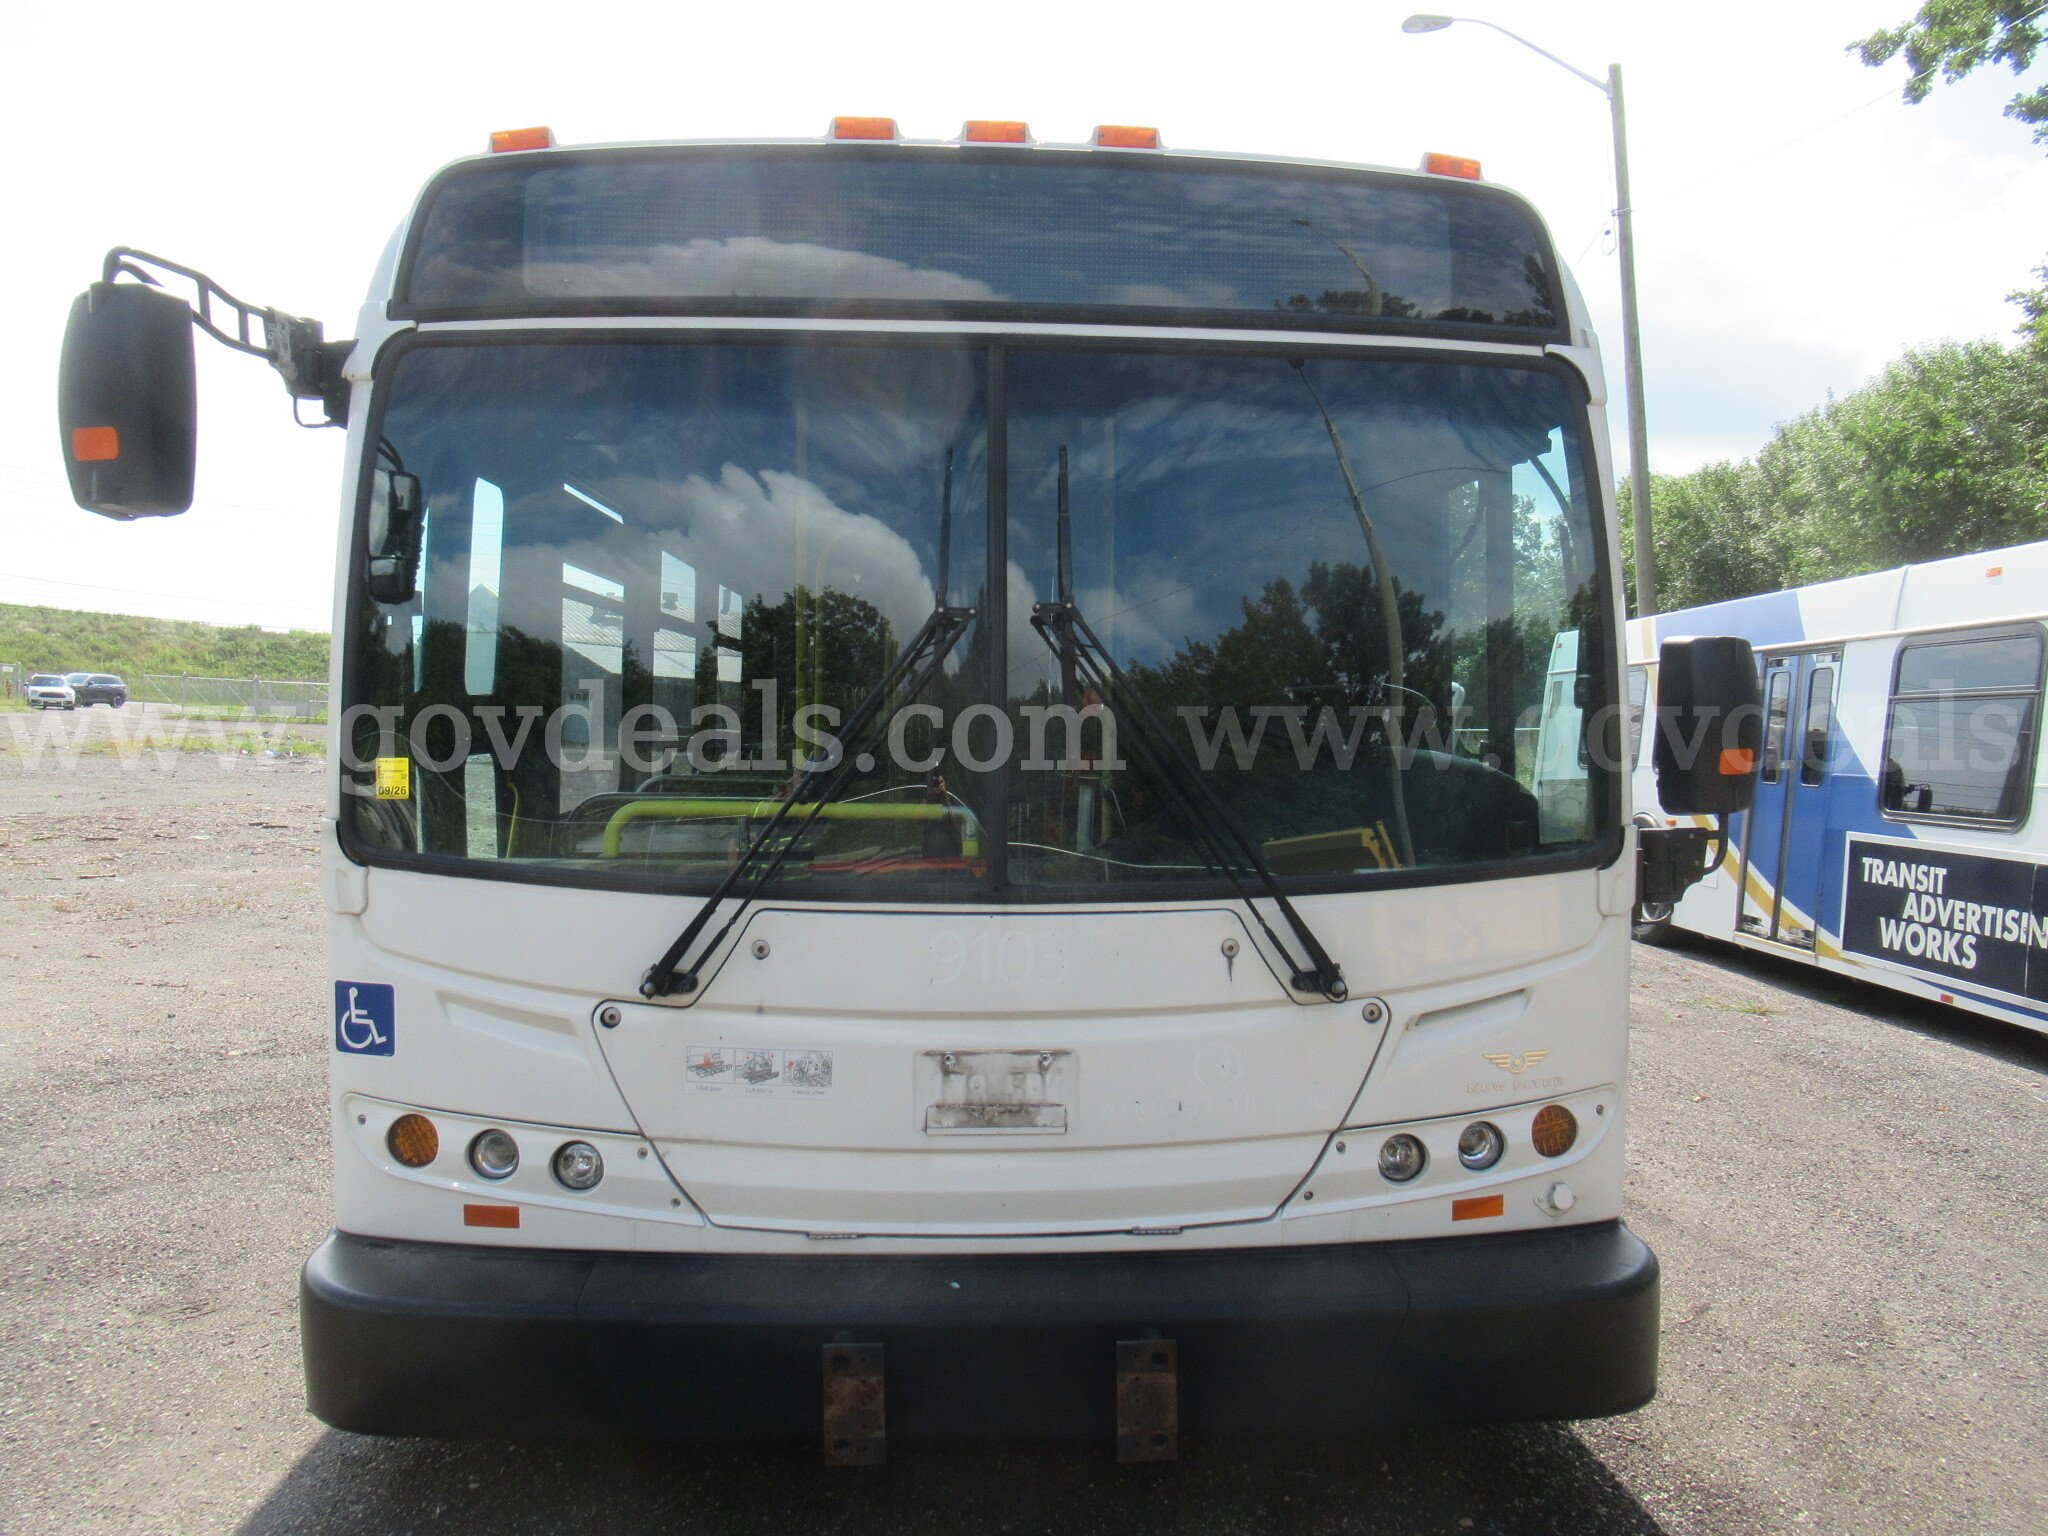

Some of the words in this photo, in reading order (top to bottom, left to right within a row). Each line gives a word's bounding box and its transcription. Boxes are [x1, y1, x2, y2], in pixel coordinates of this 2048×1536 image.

[378, 785, 407, 795] 09/26
[1862, 856, 1947, 895] TRANSIT
[1880, 917, 1978, 969] WORKS
[1902, 892, 2048, 949] ADVERTISIN
